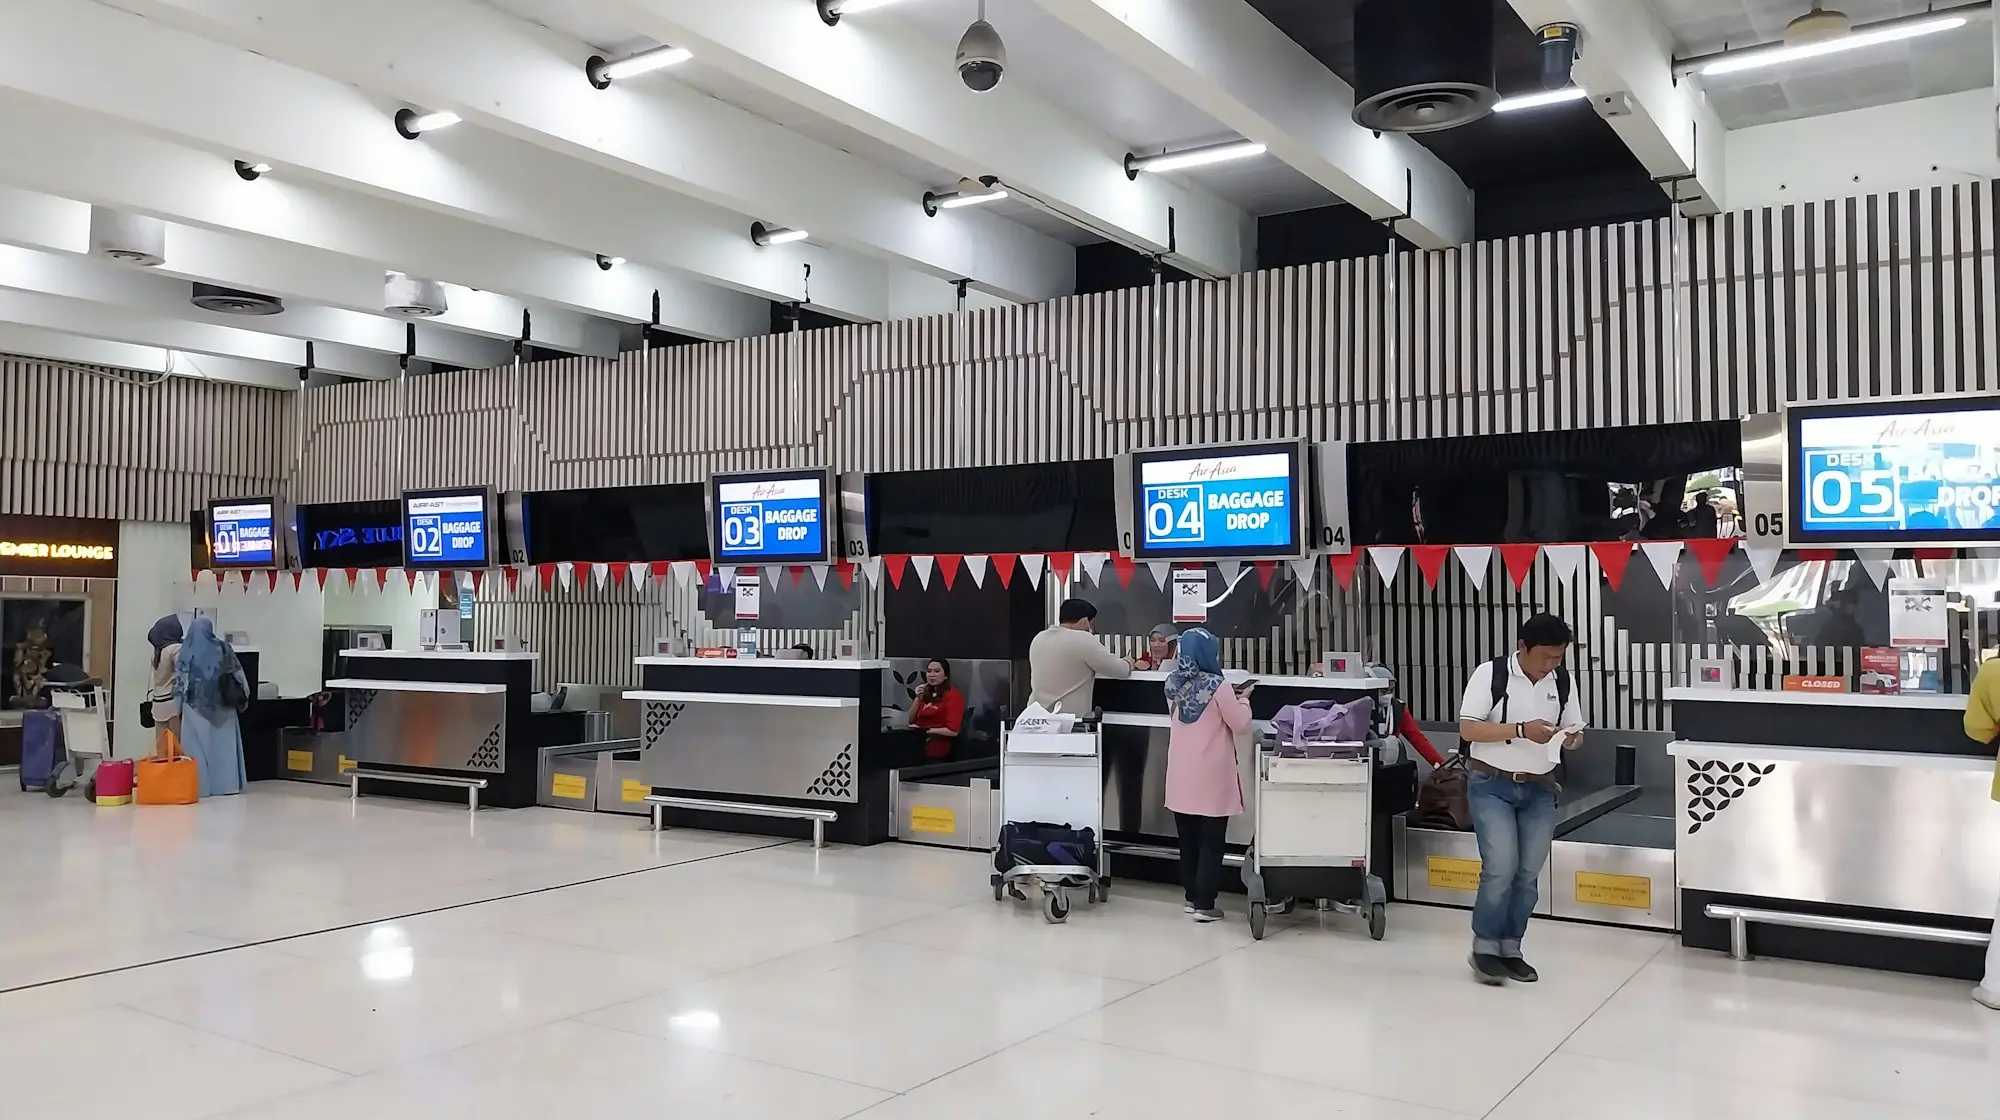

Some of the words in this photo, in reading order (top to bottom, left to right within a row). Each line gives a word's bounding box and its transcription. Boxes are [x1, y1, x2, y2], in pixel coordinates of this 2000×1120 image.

[1157, 488, 1189, 500] DESK
[1208, 490, 1285, 510] BAGGAGE
[1812, 469, 1893, 515] 05
[730, 505, 753, 515] DESK
[765, 508, 818, 524] BAGGAGE
[417, 518, 434, 526] DESK
[1149, 501, 1201, 537] 04
[1226, 512, 1271, 531] DROP
[1755, 513, 1783, 537] 05
[239, 526, 271, 538] BAGGAGE
[442, 521, 481, 534] BAGGAGE
[725, 516, 760, 546] 03
[777, 526, 808, 541] DROP
[413, 527, 440, 553] 02
[452, 536, 475, 549] DROP
[1322, 526, 1345, 546] 04
[50, 543, 114, 560] LOUNGE
[850, 540, 865, 556] 03
[513, 549, 525, 564] 02
[1801, 679, 1841, 689] CLOSED
